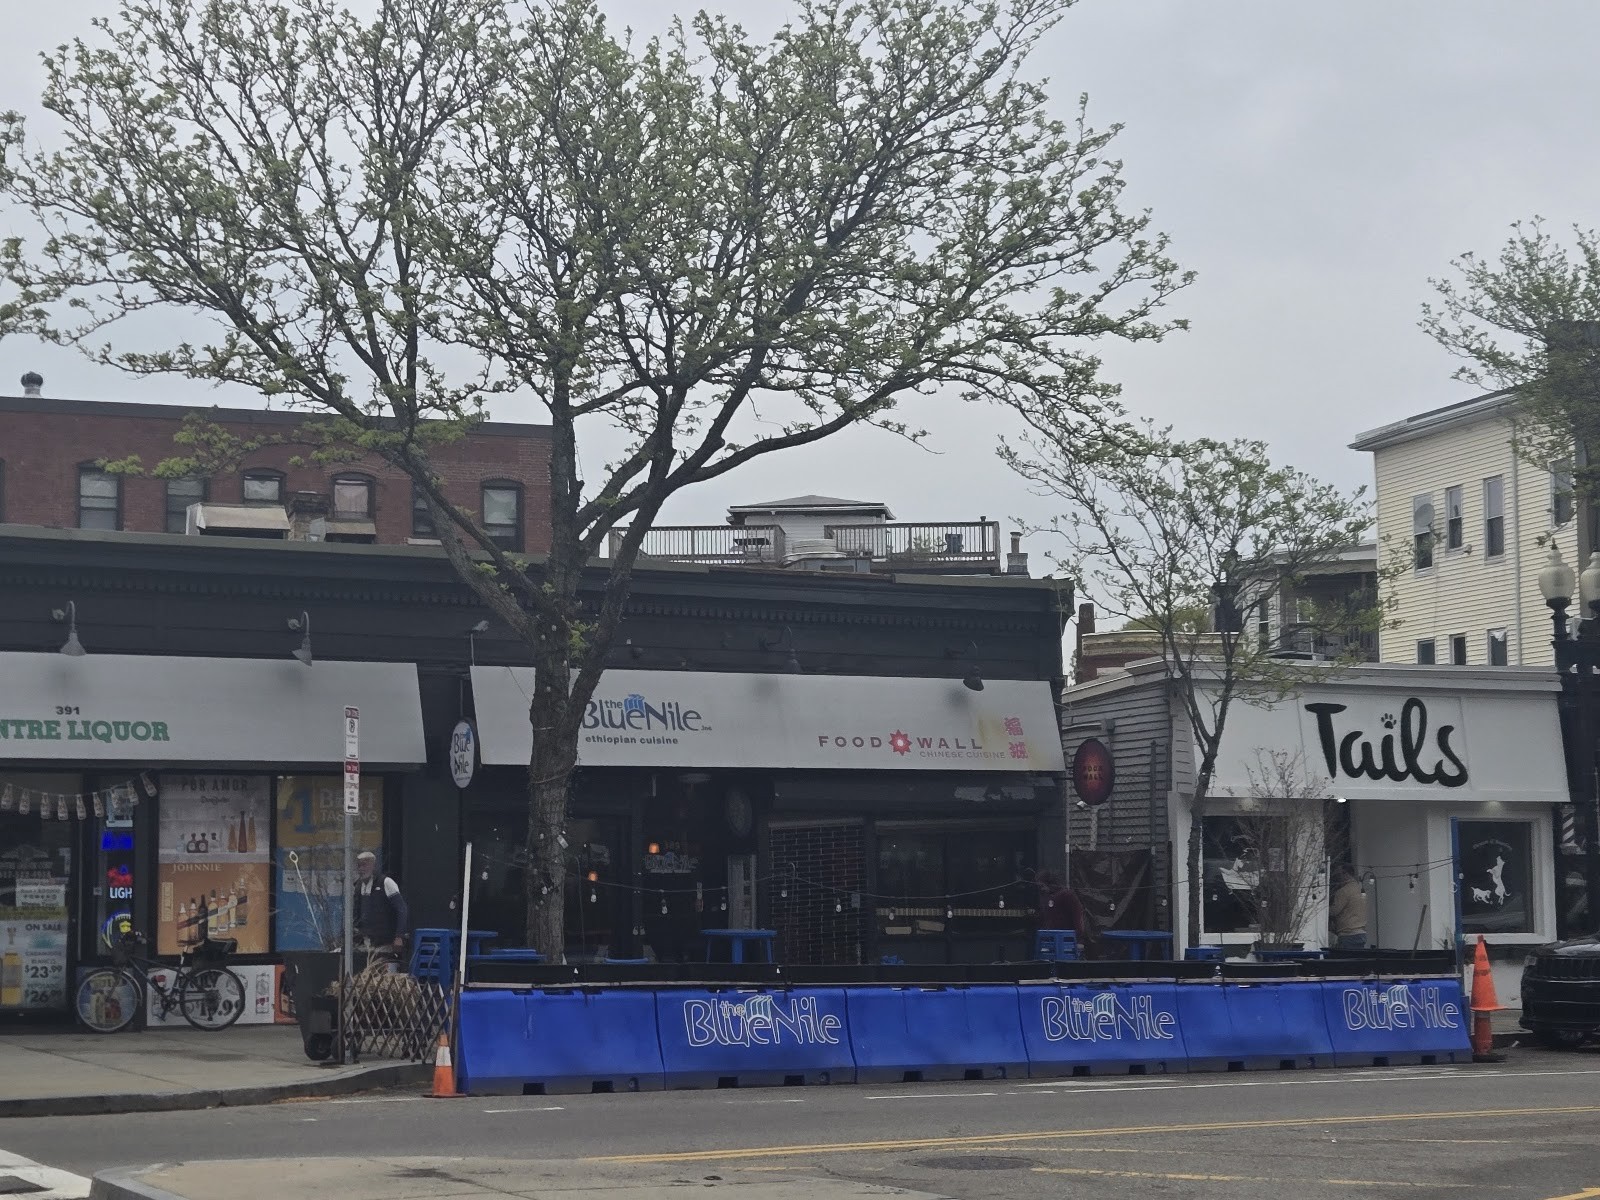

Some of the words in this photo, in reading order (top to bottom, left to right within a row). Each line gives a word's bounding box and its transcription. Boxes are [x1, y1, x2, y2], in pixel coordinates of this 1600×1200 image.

[604, 700, 623, 709] the
[55, 705, 80, 716] 391
[67, 720, 170, 744] LIQUOR
[585, 735, 637, 745] ethiopian
[639, 736, 679, 745] cuisine
[818, 735, 882, 748] FOOD
[916, 737, 983, 750] WALL
[1304, 697, 1468, 788] Tails
[919, 751, 964, 759] CHINESE
[966, 751, 1006, 760] CUISINE
[172, 863, 223, 874] JOHNNIE
[25, 923, 40, 931] ON
[42, 923, 62, 931] SALE
[719, 1001, 746, 1018] the
[1072, 997, 1093, 1013] the
